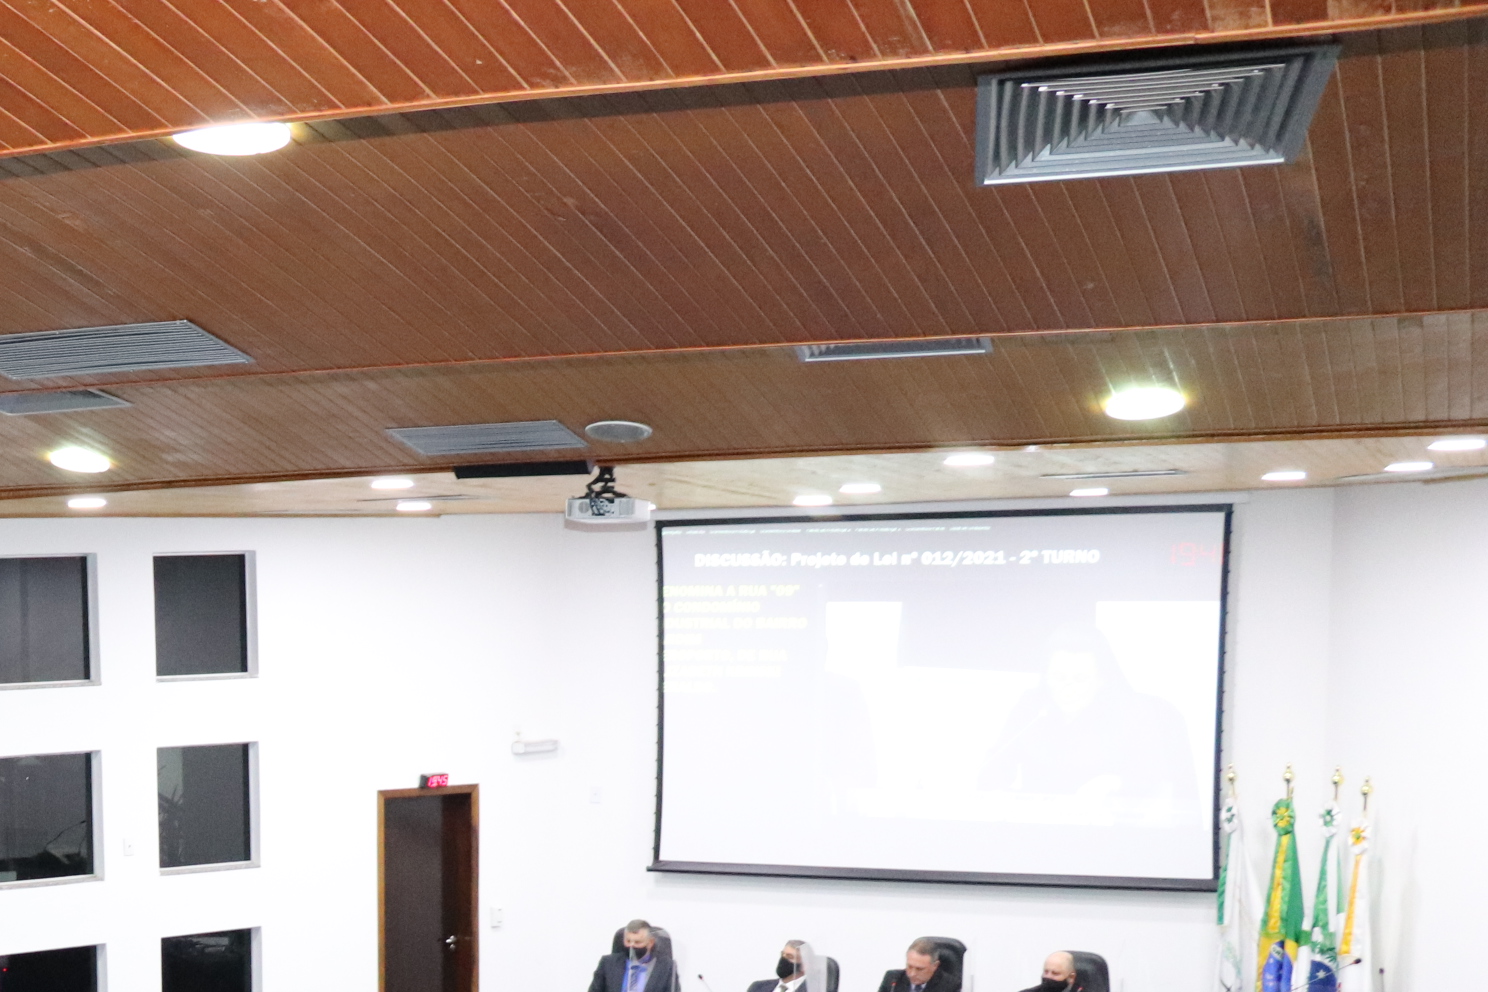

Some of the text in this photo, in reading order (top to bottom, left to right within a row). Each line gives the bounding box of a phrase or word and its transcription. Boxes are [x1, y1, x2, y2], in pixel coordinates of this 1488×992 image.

[693, 550, 786, 567] DISCUSSÃO:
[791, 551, 846, 568] Projeto
[850, 551, 870, 565] de
[873, 551, 896, 565] Lei
[920, 550, 1007, 567] 012/2021
[1041, 549, 1100, 564] TURNO
[738, 585, 767, 597] RUA
